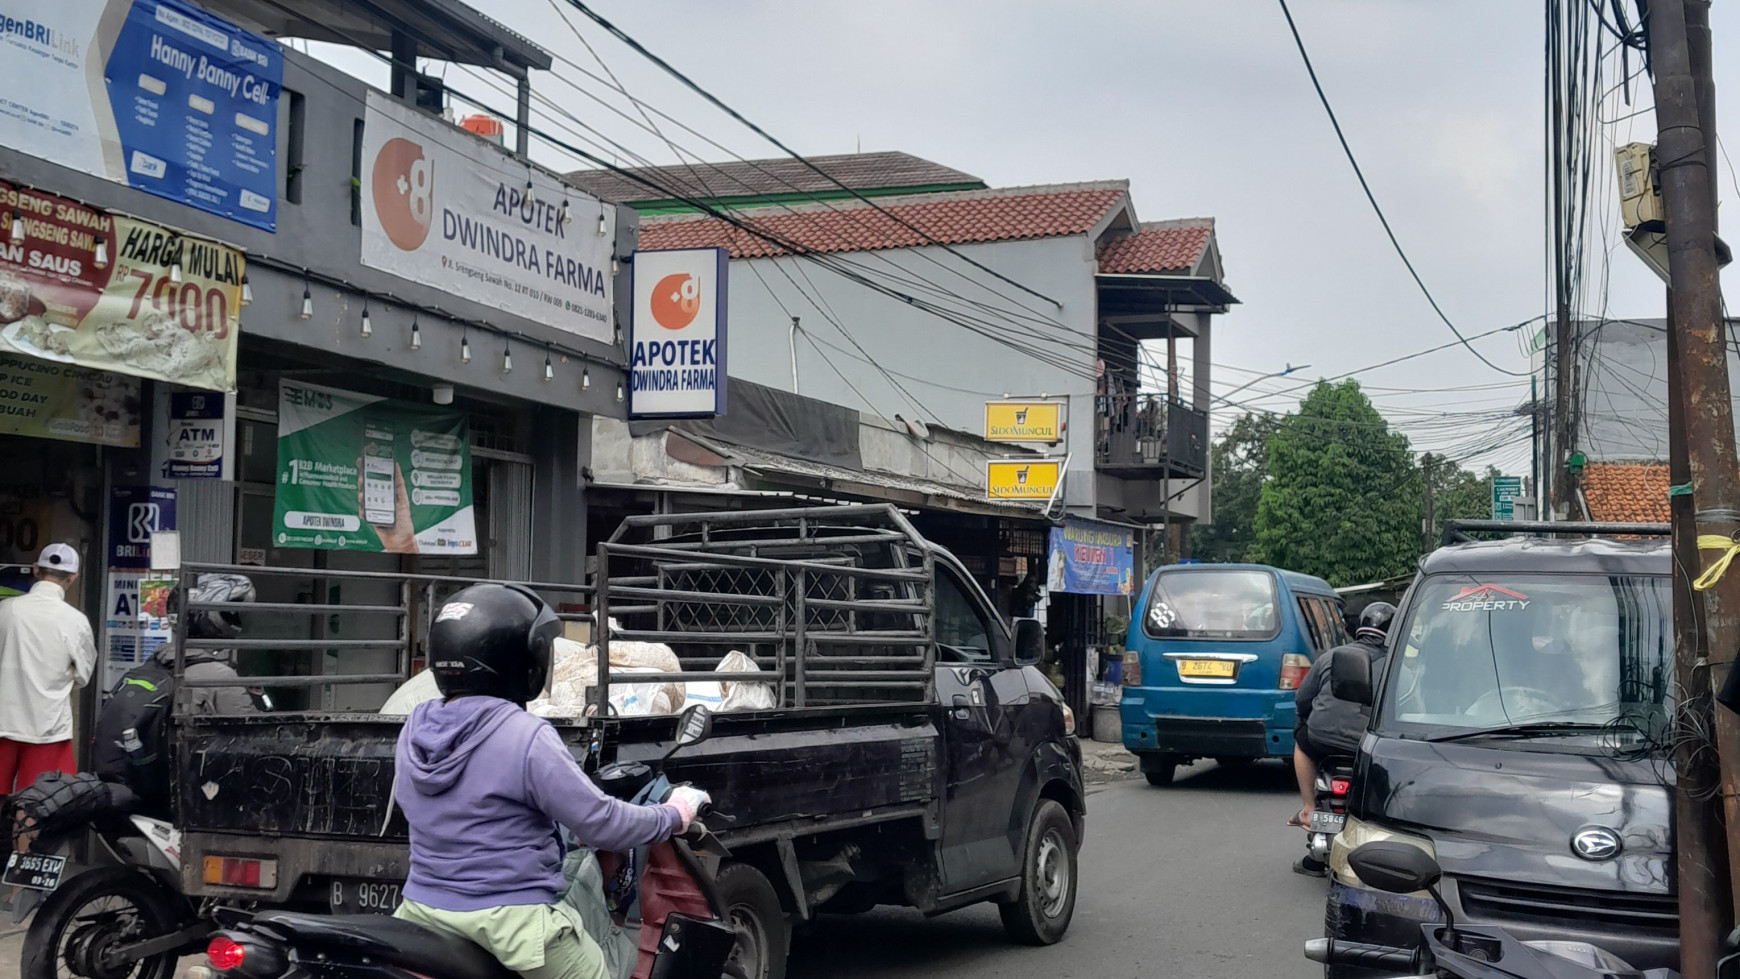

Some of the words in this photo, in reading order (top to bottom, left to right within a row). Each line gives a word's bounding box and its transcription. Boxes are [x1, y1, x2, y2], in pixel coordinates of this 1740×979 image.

[151, 34, 197, 80] Hanny
[197, 55, 241, 98] Banny
[56, 204, 111, 232] SAWAH
[493, 183, 564, 239] APOTEK
[28, 249, 82, 277] SAUS
[120, 226, 184, 272] HARGA
[188, 242, 239, 287] MULAI
[443, 208, 541, 275] DWINDRA
[546, 250, 605, 299] FARMA
[126, 268, 229, 340] 7000
[632, 339, 716, 367] APOTEK
[11, 375, 34, 387] ICE
[681, 368, 715, 391] FARMA
[21, 392, 48, 404] DAY
[180, 428, 215, 441] ATM
[1442, 600, 1531, 612] PROPERTY
[333, 881, 343, 905] B
[359, 883, 399, 909] 9627
